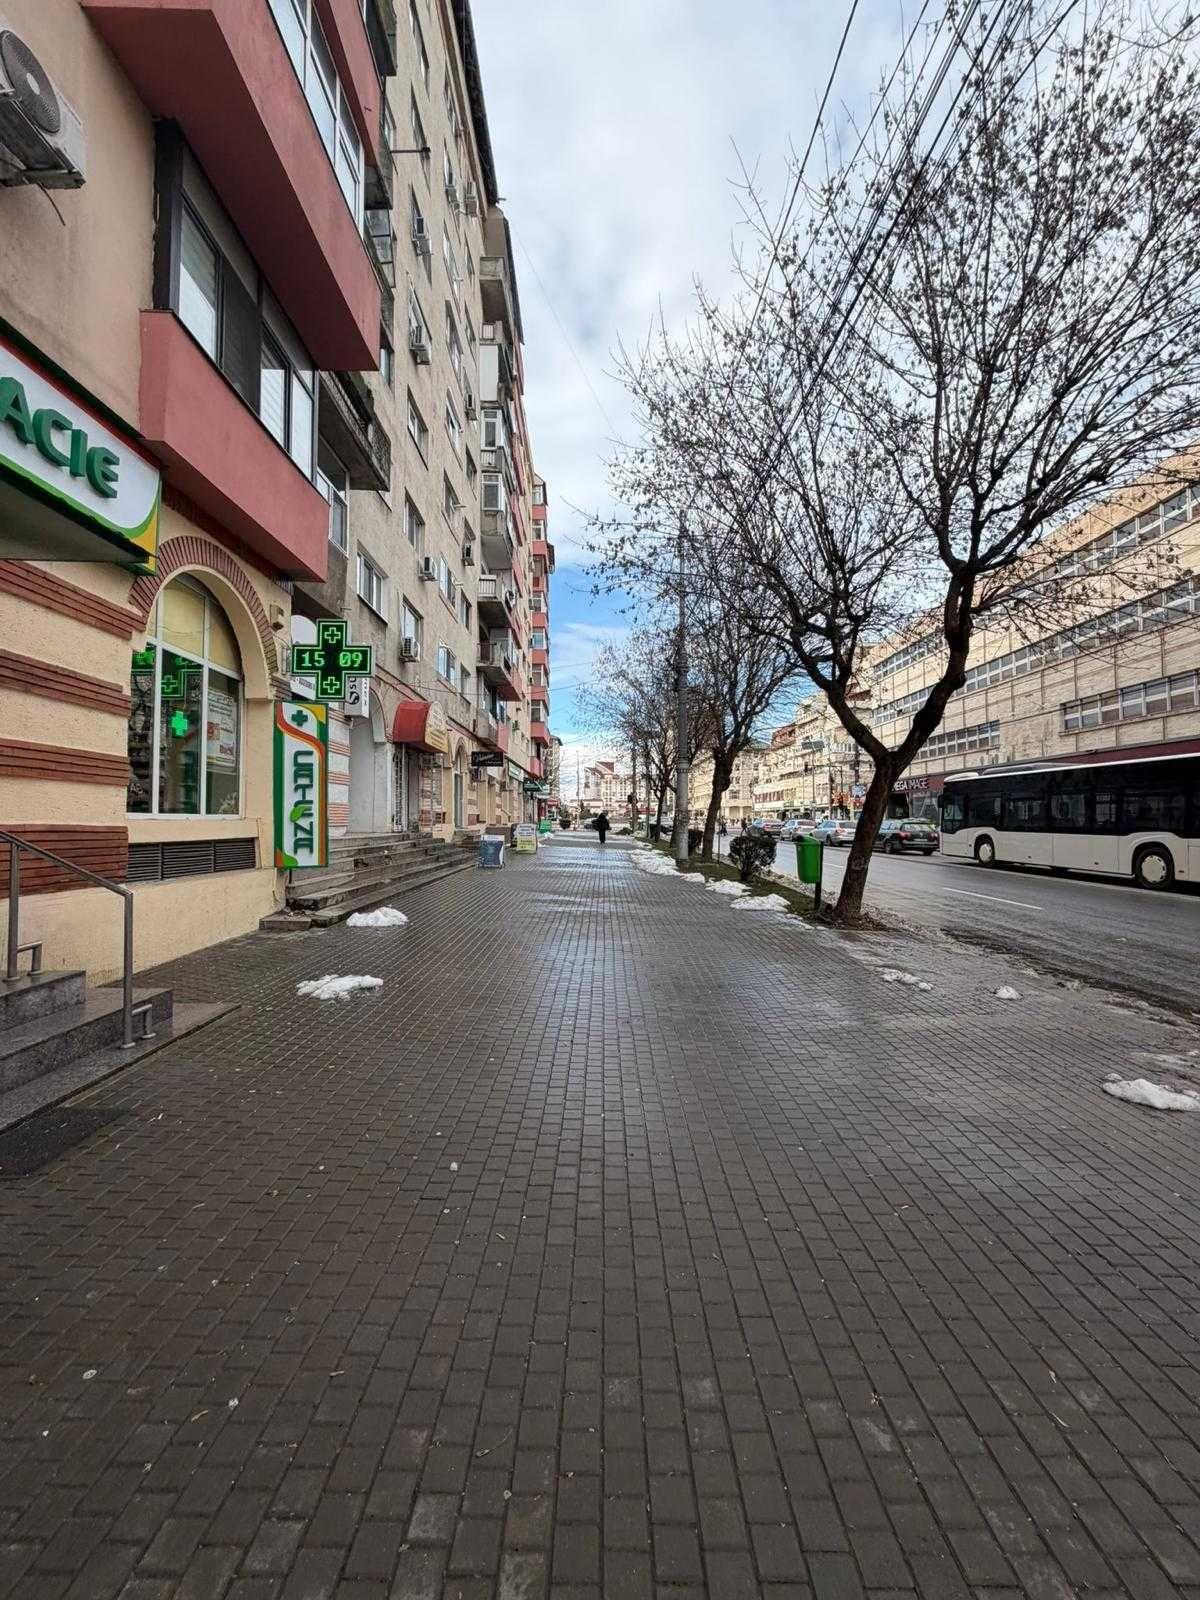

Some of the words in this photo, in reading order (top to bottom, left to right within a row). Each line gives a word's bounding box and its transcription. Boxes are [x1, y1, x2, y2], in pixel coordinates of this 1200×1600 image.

[0, 377, 120, 498] ACIE
[301, 651, 325, 667] 15
[339, 651, 362, 667] 09
[291, 750, 314, 855] CATENA
